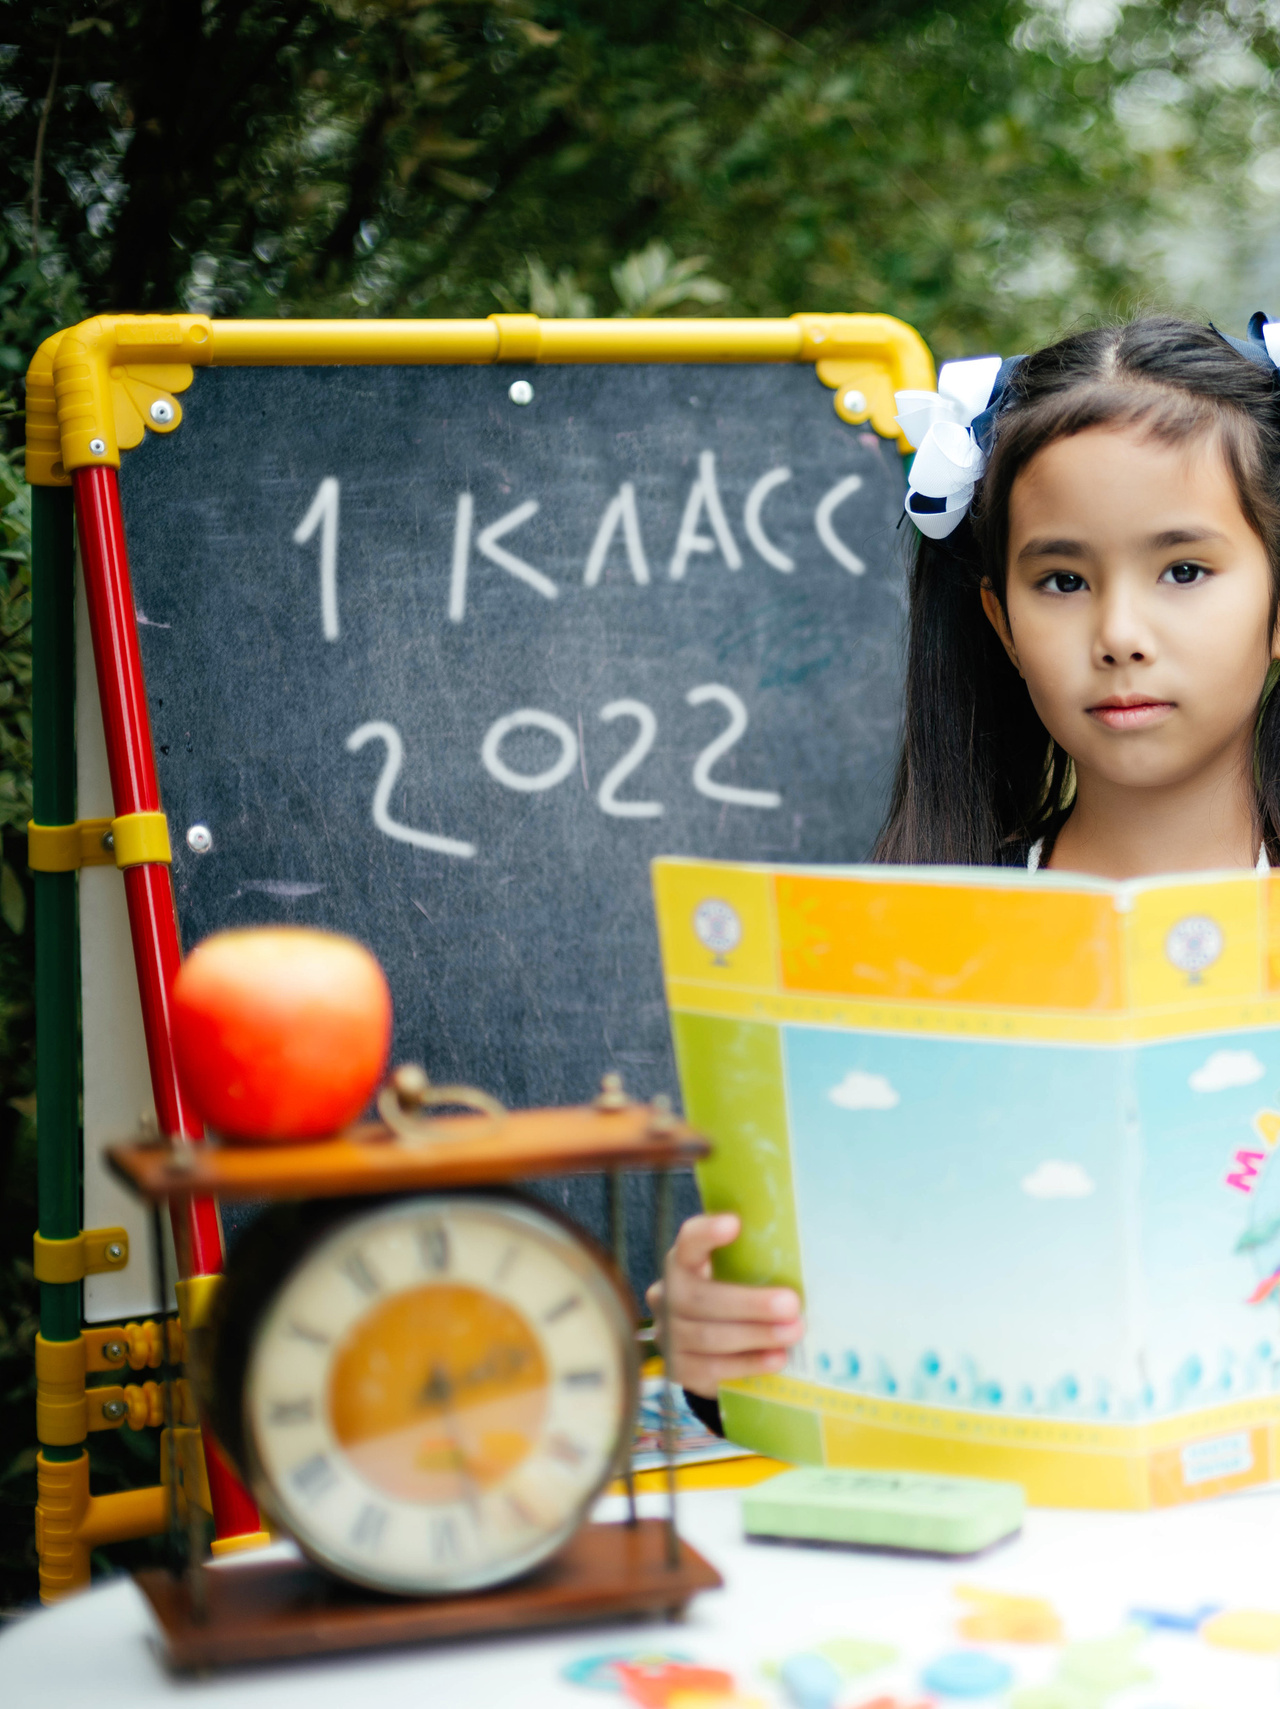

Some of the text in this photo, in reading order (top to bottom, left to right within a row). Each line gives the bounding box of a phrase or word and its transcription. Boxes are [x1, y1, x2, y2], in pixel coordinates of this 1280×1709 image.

[294, 450, 866, 641] 1 КЛАСС
[347, 684, 784, 858] 2022
